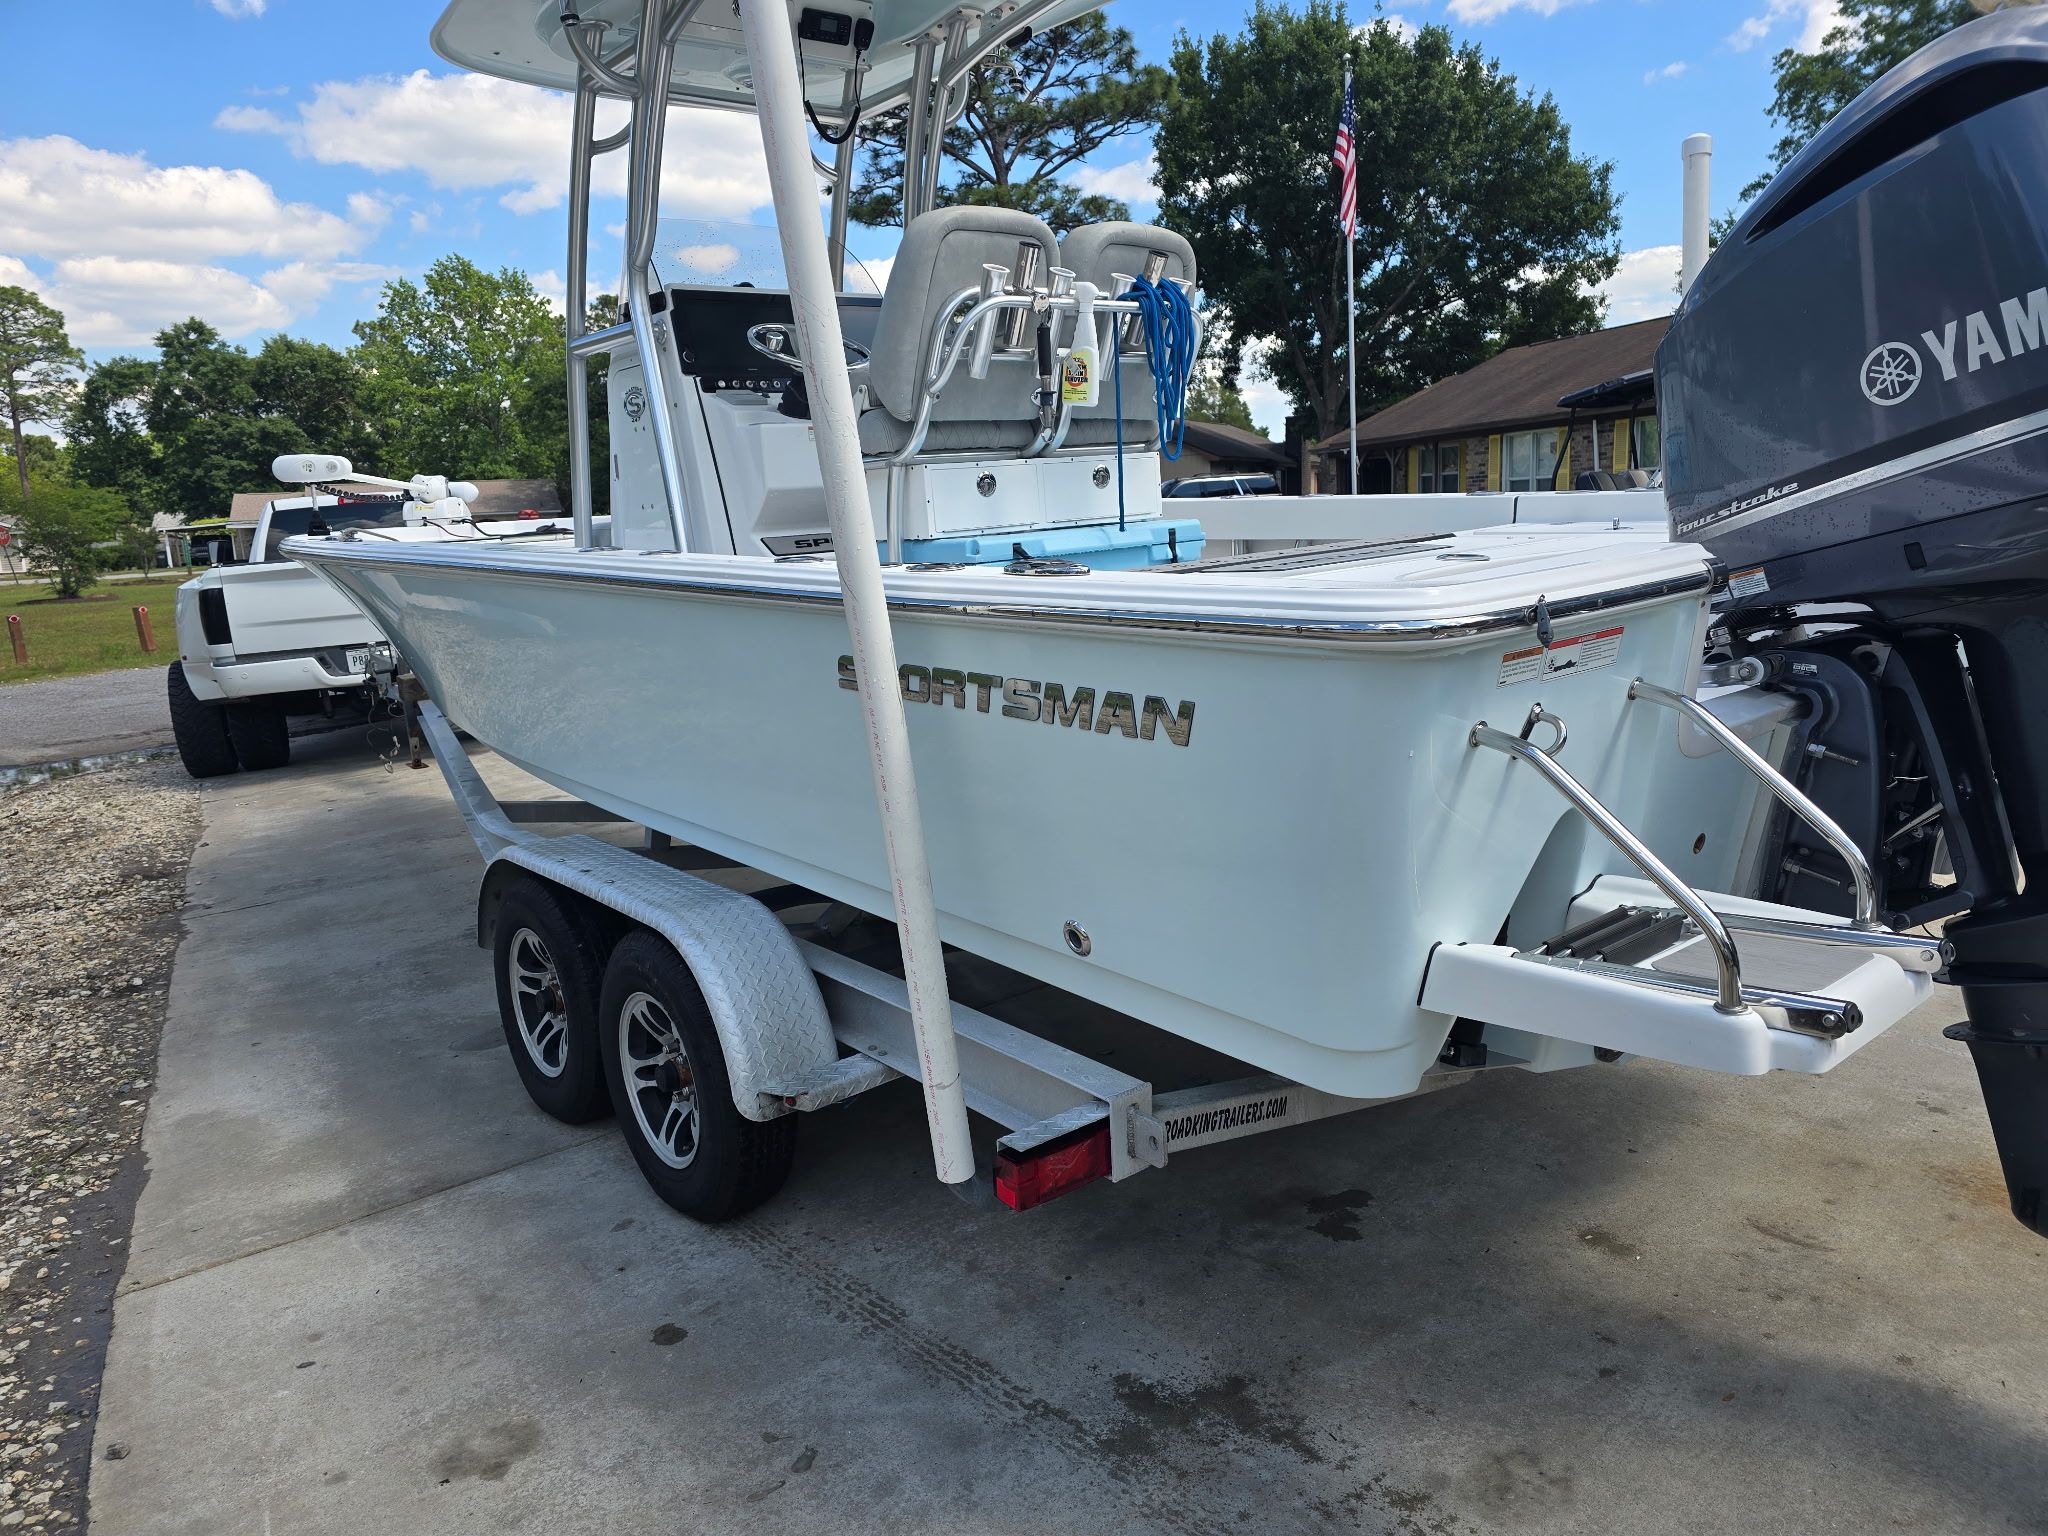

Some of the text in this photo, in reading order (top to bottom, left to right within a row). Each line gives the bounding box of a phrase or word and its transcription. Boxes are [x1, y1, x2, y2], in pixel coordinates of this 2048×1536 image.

[794, 536, 833, 549] SP
[838, 654, 1196, 747] SORTSMAN
[1165, 1096, 1288, 1143] ROADKINGTRAILERS.COM
